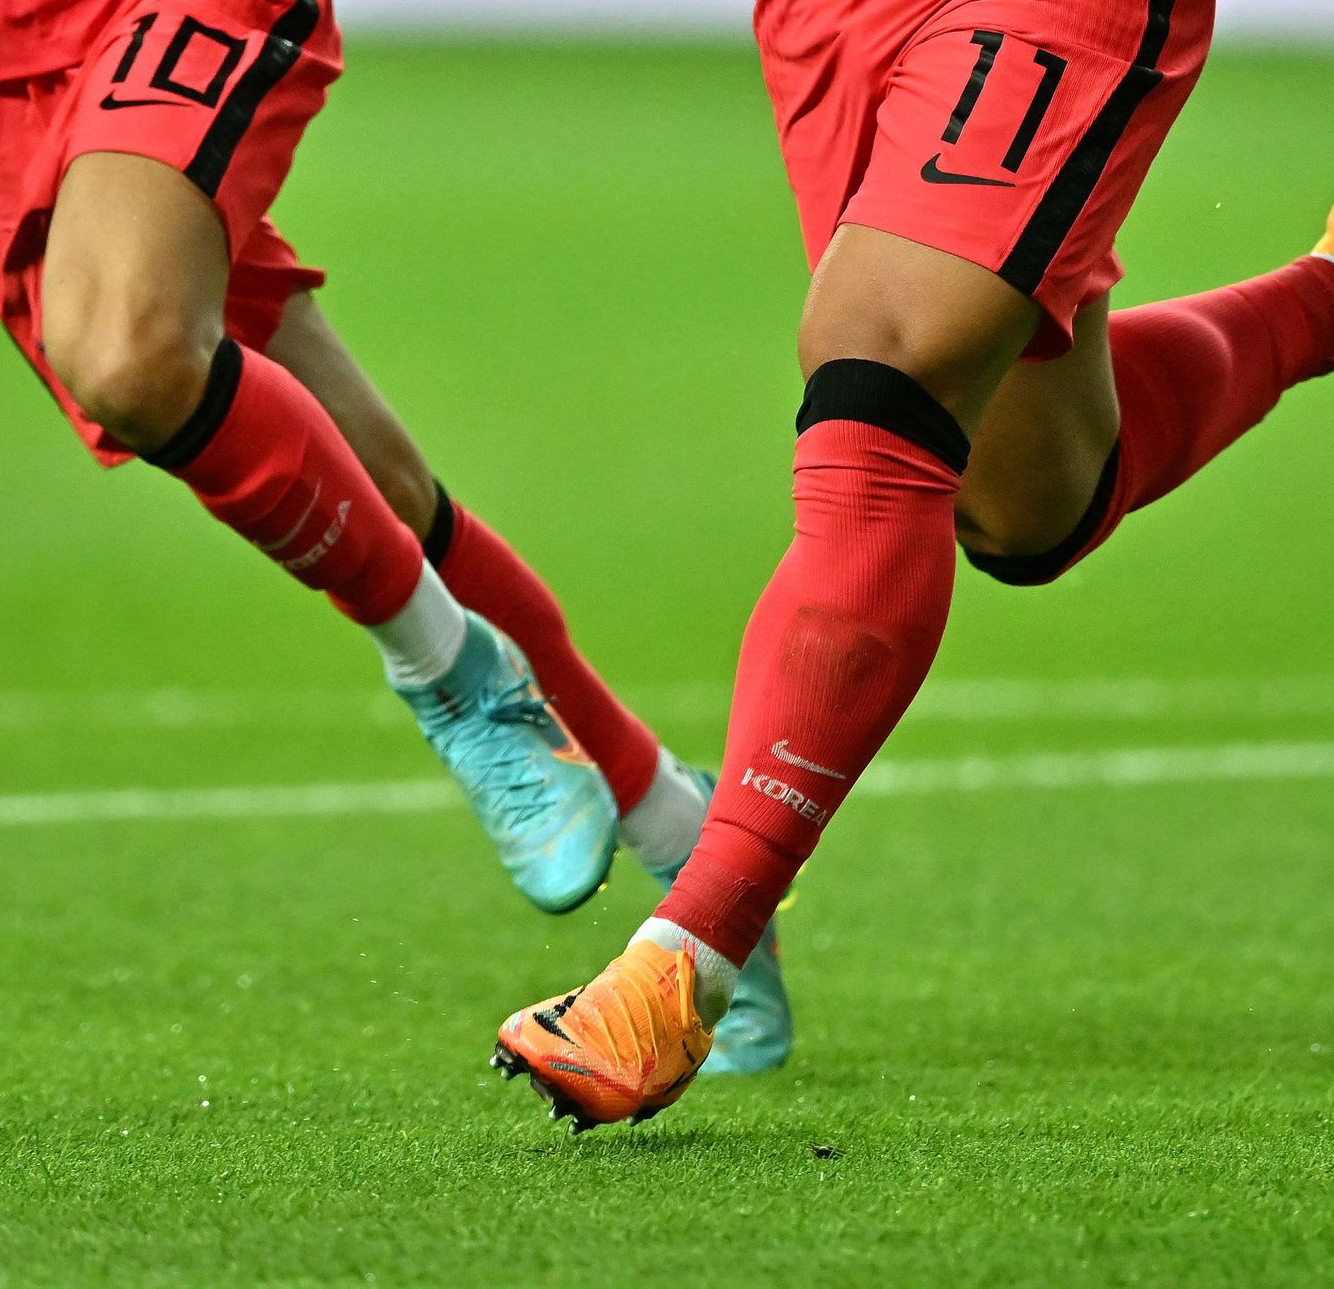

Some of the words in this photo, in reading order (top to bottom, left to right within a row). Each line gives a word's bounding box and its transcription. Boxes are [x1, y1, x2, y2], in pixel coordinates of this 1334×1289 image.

[112, 12, 247, 109] 10
[940, 29, 1068, 173] 11
[741, 767, 827, 826] KOREA
